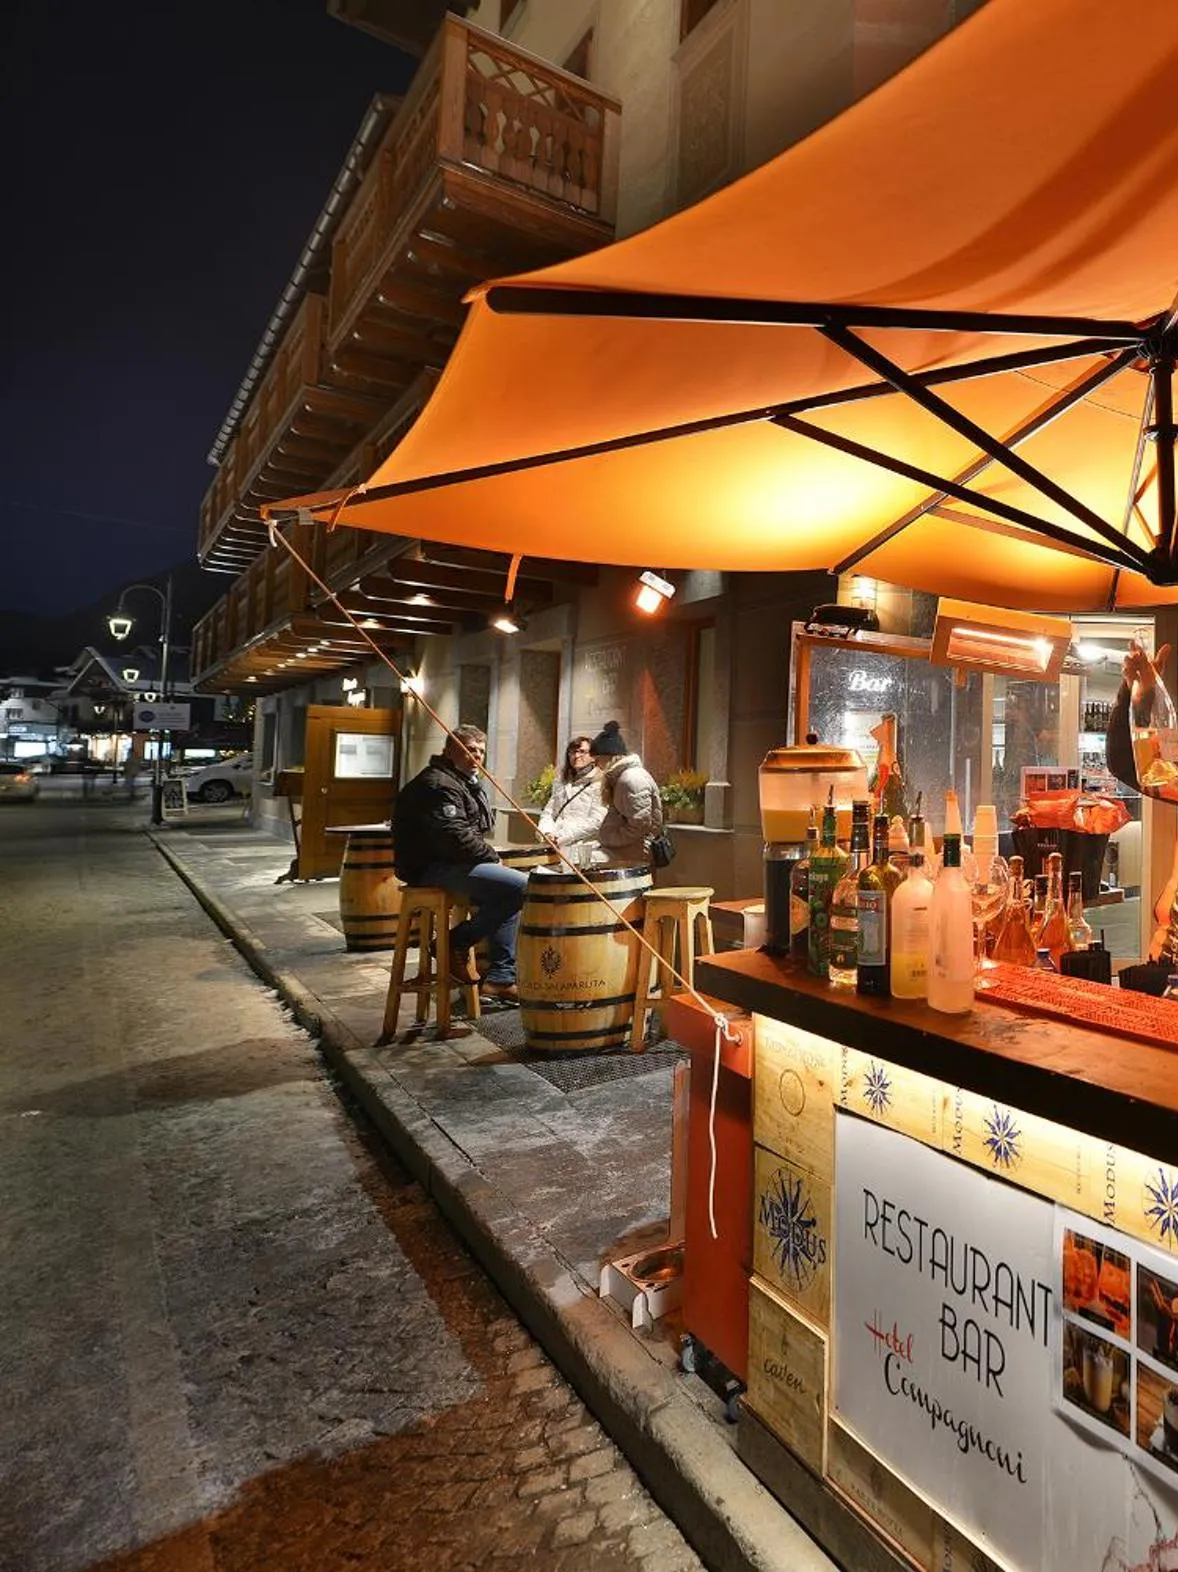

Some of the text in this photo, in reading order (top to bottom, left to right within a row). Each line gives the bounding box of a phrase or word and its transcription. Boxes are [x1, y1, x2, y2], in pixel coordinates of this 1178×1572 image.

[848, 669, 892, 692] Bar
[759, 1195, 828, 1266] MODUS
[863, 1188, 1053, 1348] RESTAURANT
[864, 1308, 914, 1364] Hotel
[939, 1302, 1005, 1398] BAR
[884, 1353, 1027, 1484] Compagnoni
